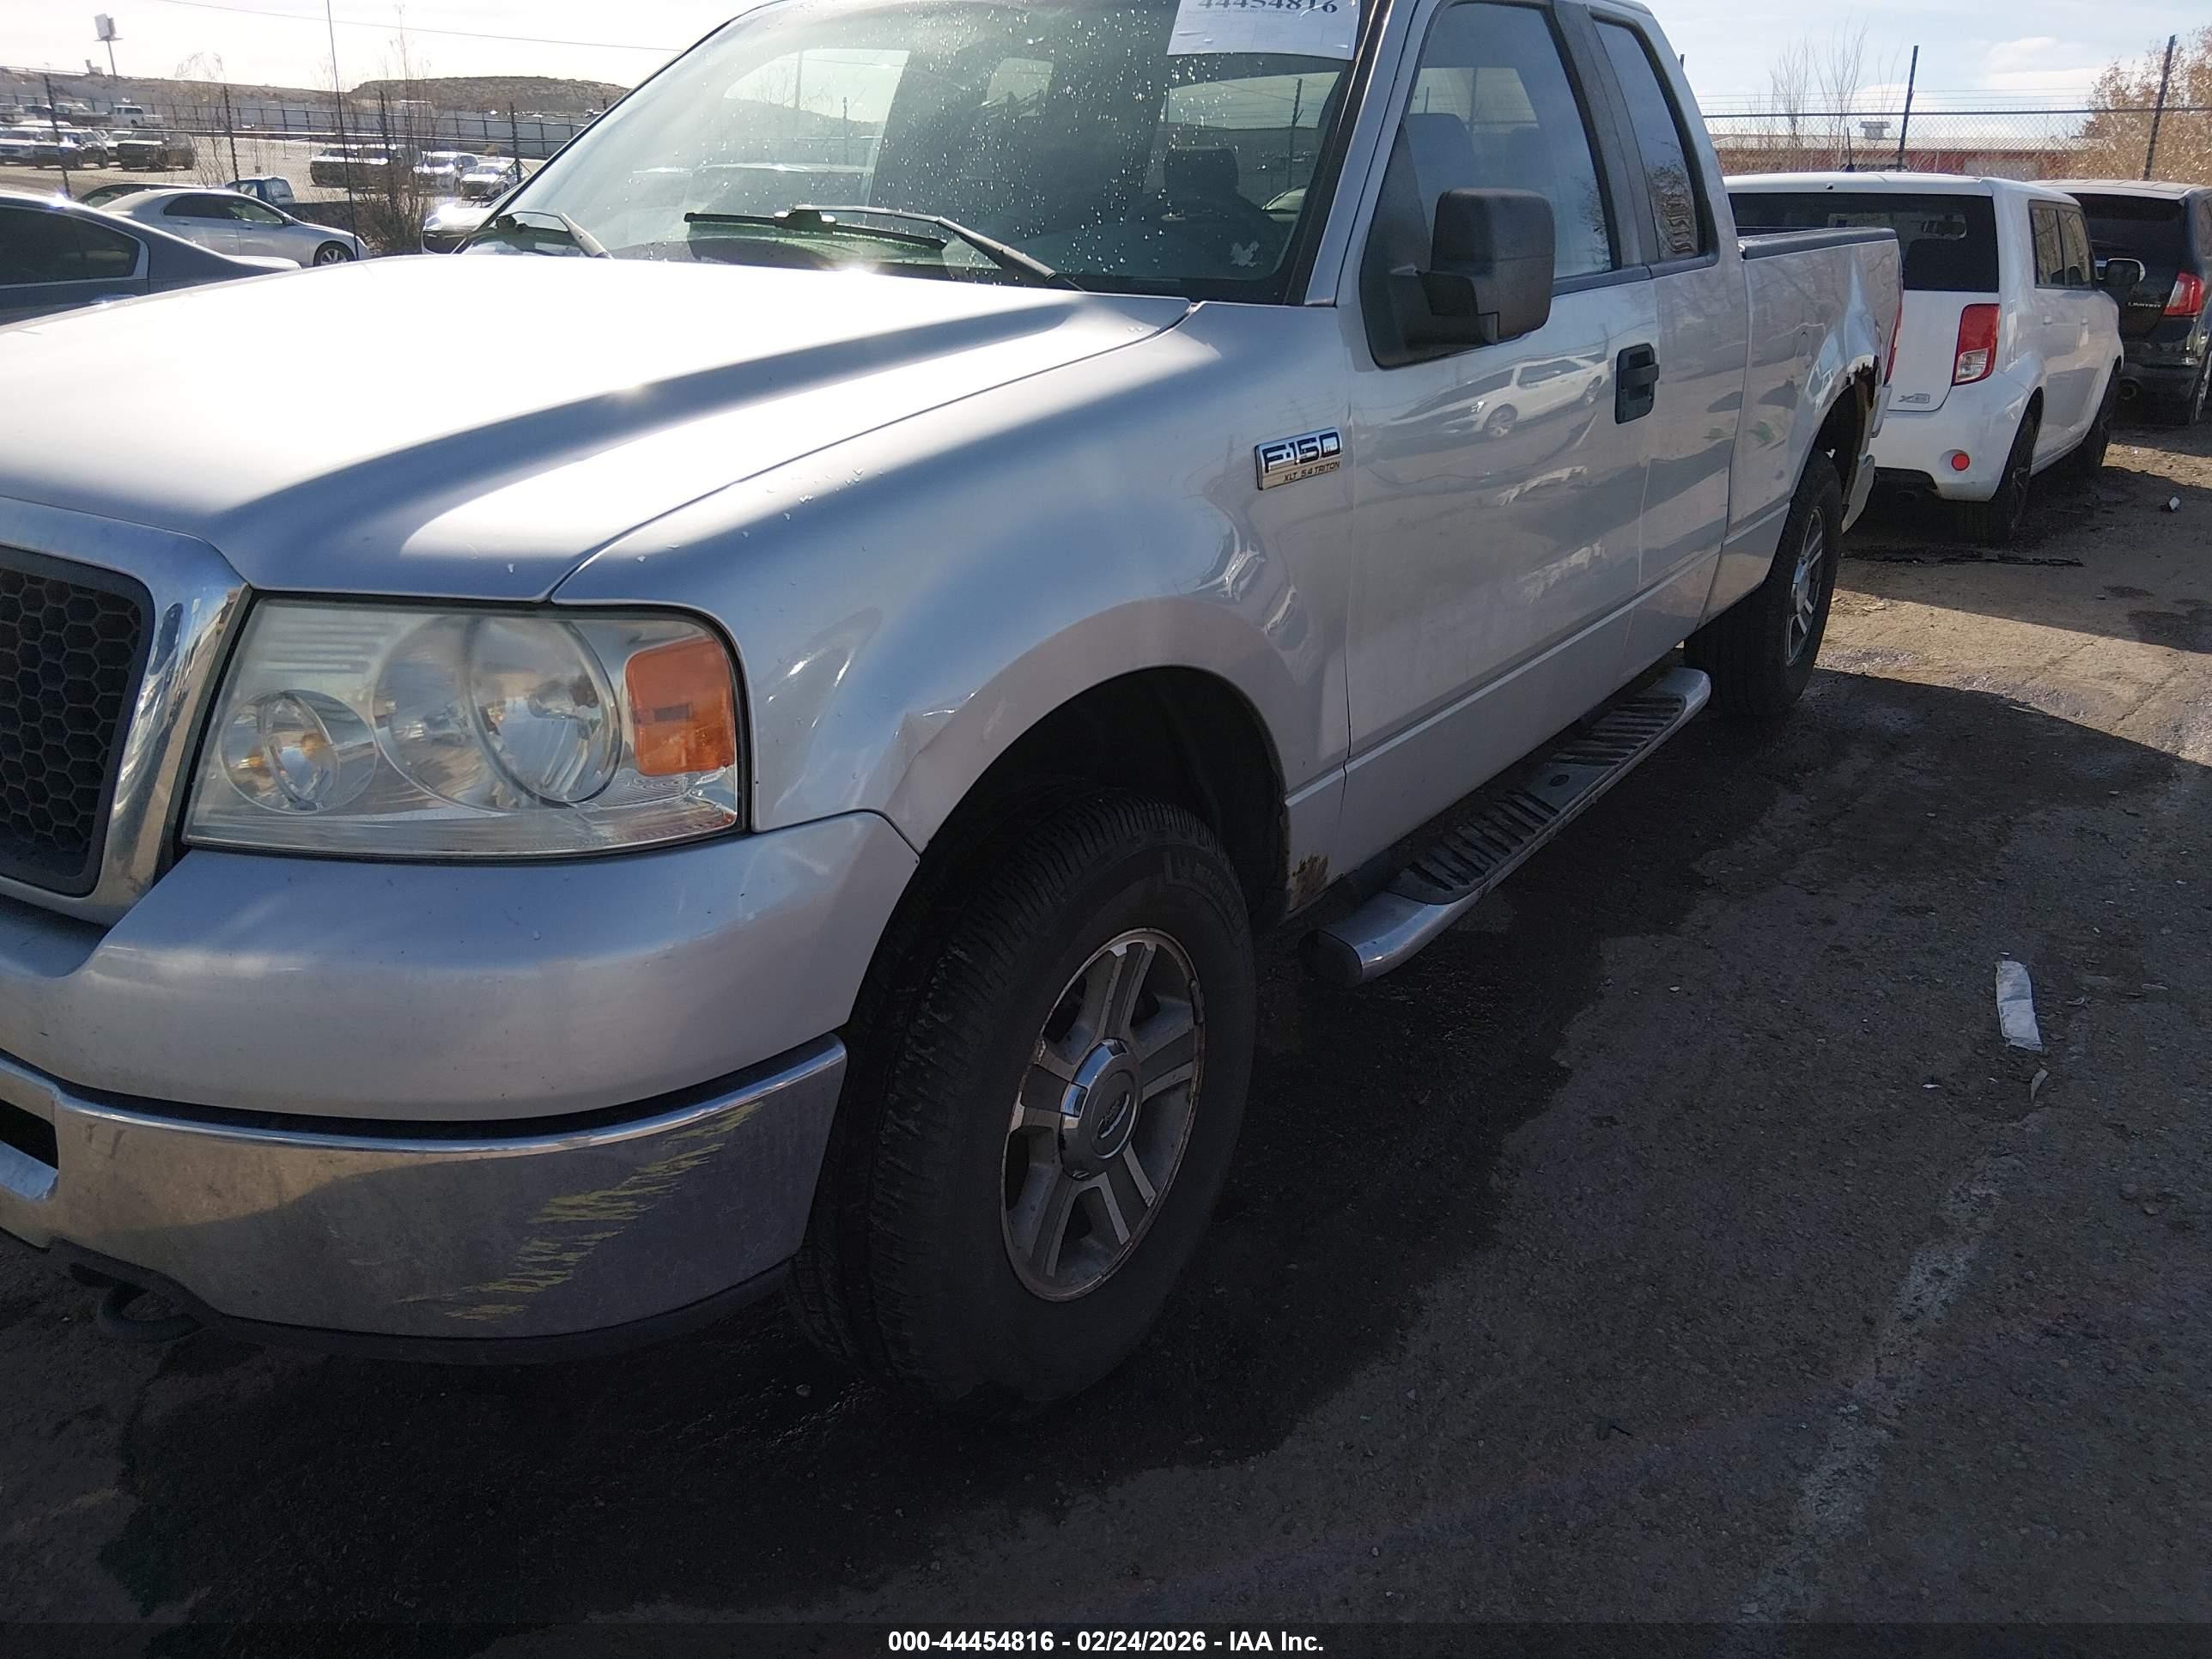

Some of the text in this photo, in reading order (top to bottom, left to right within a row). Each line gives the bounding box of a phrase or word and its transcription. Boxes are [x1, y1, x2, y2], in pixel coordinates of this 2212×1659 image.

[1261, 431, 1340, 473] F-150
[1283, 471, 1298, 483] XLT
[1314, 460, 1340, 475] TRITON
